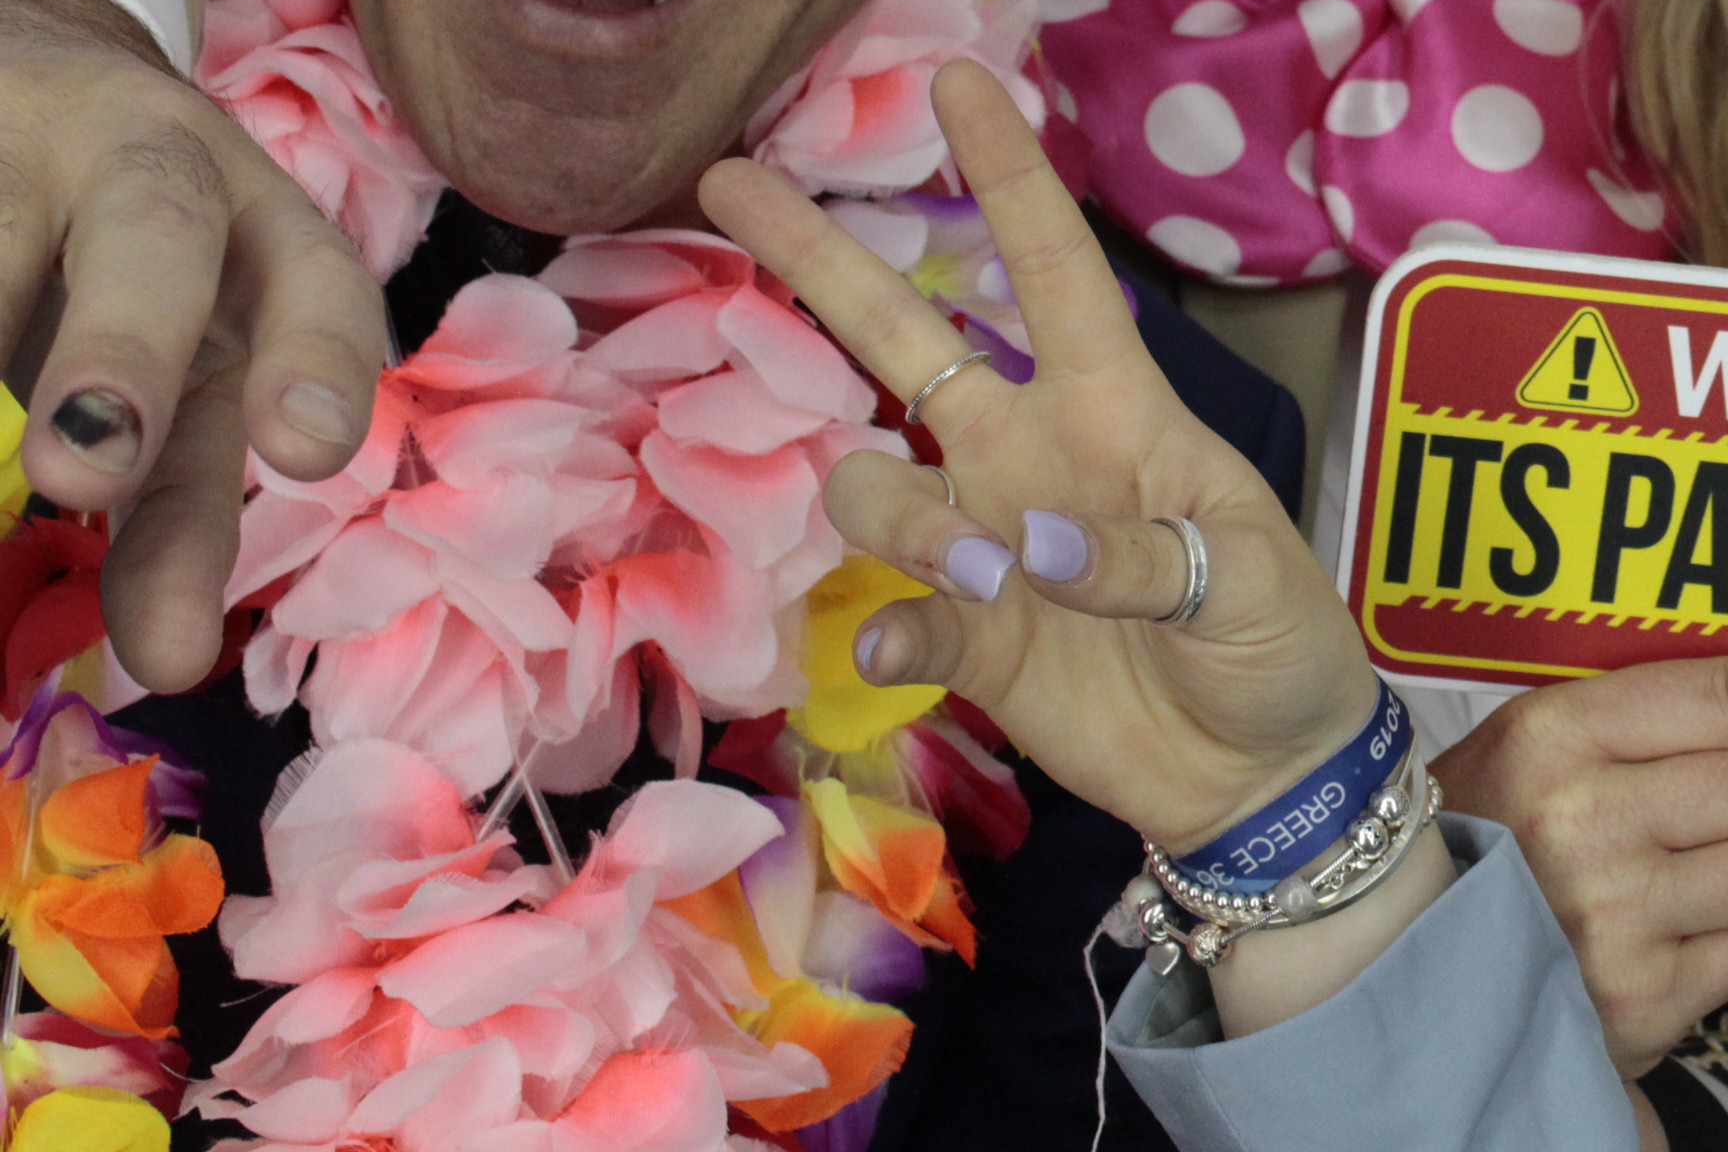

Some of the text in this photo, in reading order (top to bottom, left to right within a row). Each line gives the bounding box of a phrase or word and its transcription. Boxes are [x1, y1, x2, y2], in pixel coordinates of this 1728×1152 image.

[1383, 431, 1572, 598] ITS
[1369, 689, 1401, 761] 2019
[1229, 781, 1347, 875] GREECE
